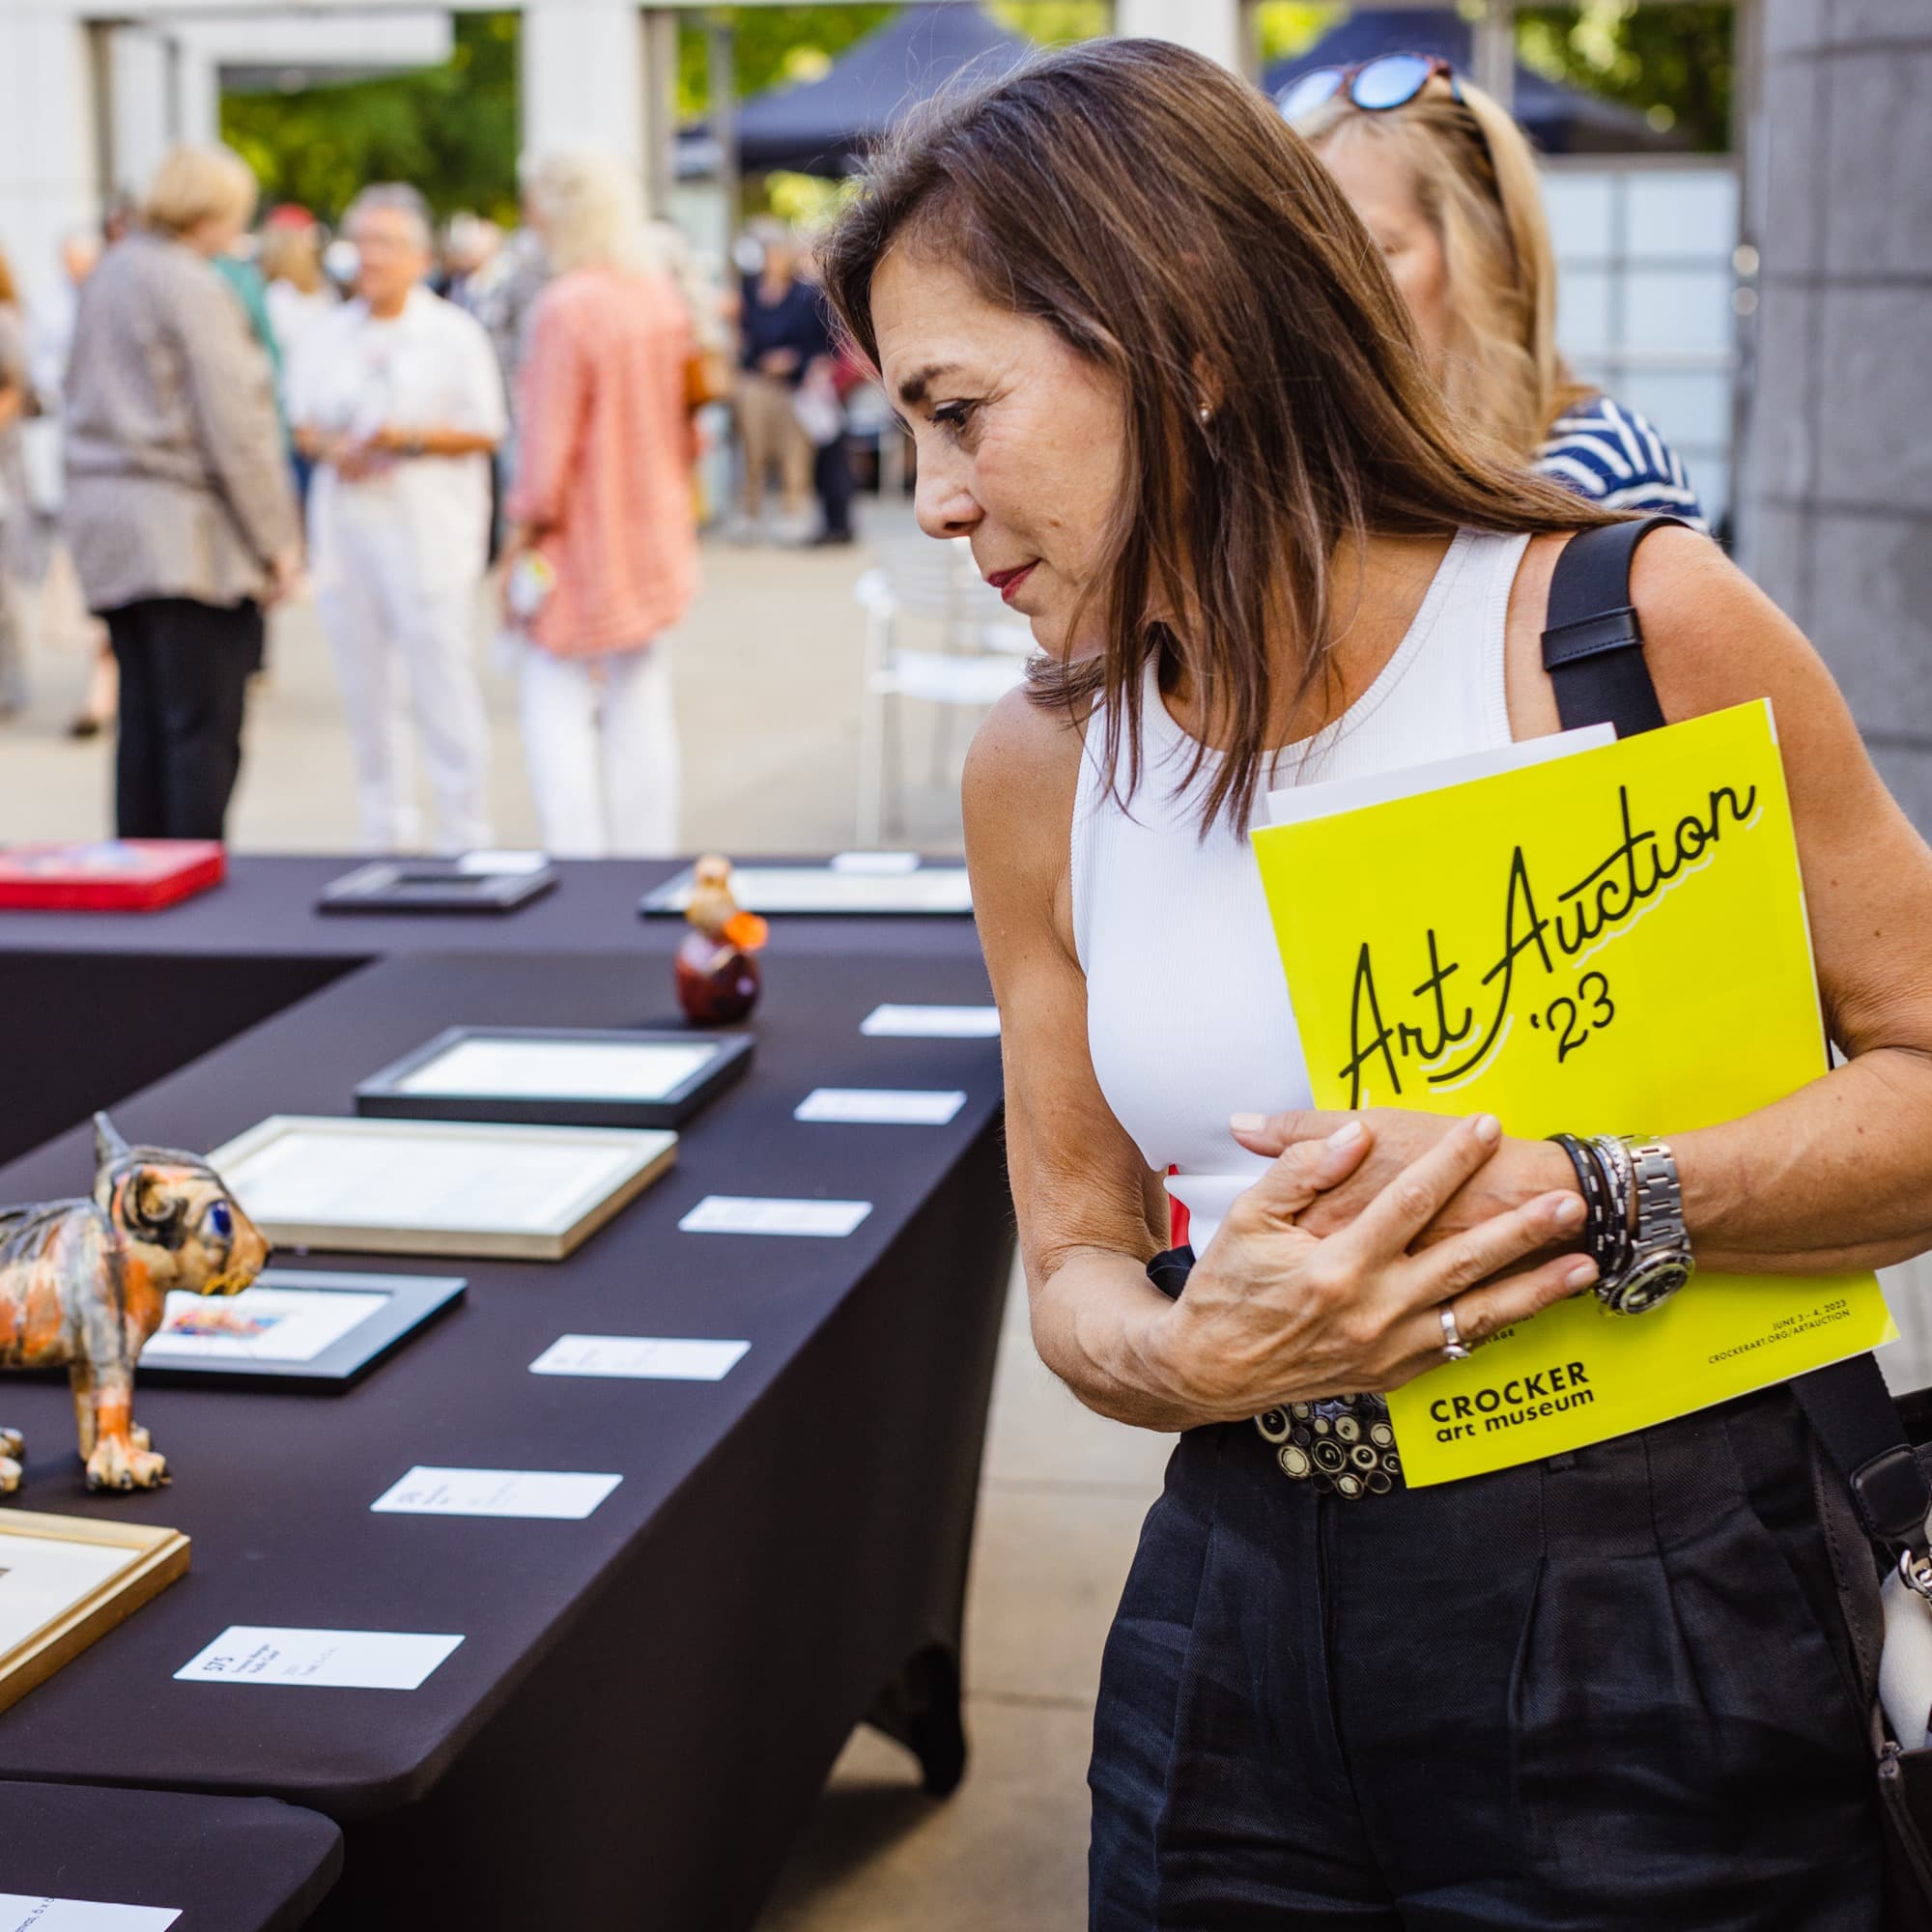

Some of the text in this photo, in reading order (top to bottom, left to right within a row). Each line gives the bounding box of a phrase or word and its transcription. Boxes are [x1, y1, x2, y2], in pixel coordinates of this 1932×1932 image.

[1339, 784, 1756, 1110] Art Auction
[1530, 972, 1616, 1063] '23
[1708, 1309, 1851, 1364] CROCKERART.ORG/ARTAUCTION
[1773, 1316, 1796, 1330] JUNE
[1798, 1314, 1804, 1322] 3
[1824, 1299, 1847, 1313] 2023
[1430, 1361, 1589, 1423] CROCKER
[1436, 1388, 1595, 1443] art museum
